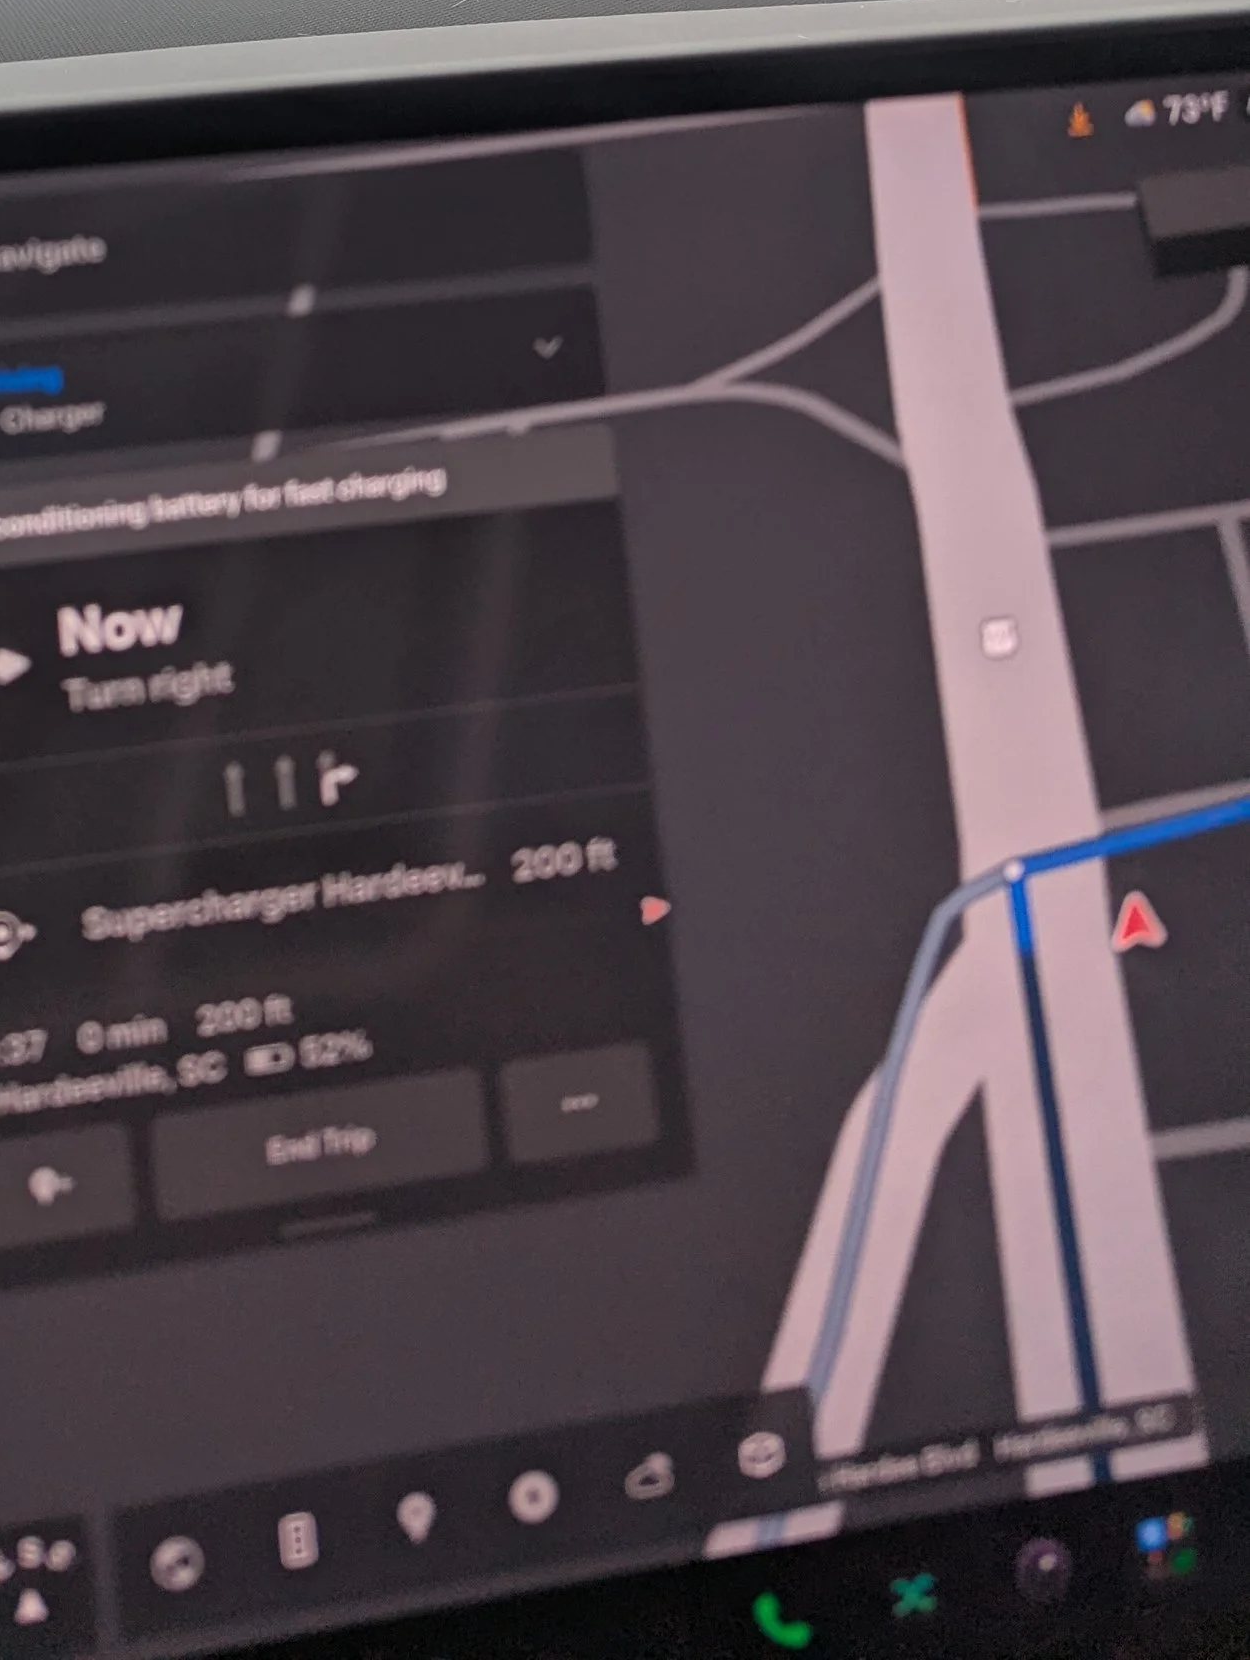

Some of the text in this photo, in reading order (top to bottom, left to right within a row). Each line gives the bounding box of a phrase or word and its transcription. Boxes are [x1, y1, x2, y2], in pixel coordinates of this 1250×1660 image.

[0, 400, 107, 436] Charger
[147, 488, 242, 523] battery
[243, 482, 282, 511] for
[284, 477, 336, 508] fast
[335, 466, 448, 502] charging
[56, 602, 183, 657] Now
[62, 658, 236, 713] Turn right
[81, 882, 319, 942] Supercharger
[510, 840, 583, 884] 200
[586, 835, 618, 872] ft
[76, 1020, 104, 1054] 0
[105, 1013, 168, 1050] min
[195, 996, 263, 1038] 200
[264, 993, 294, 1027] ft
[177, 1049, 228, 1088] SC
[264, 1124, 378, 1166] End Trip
